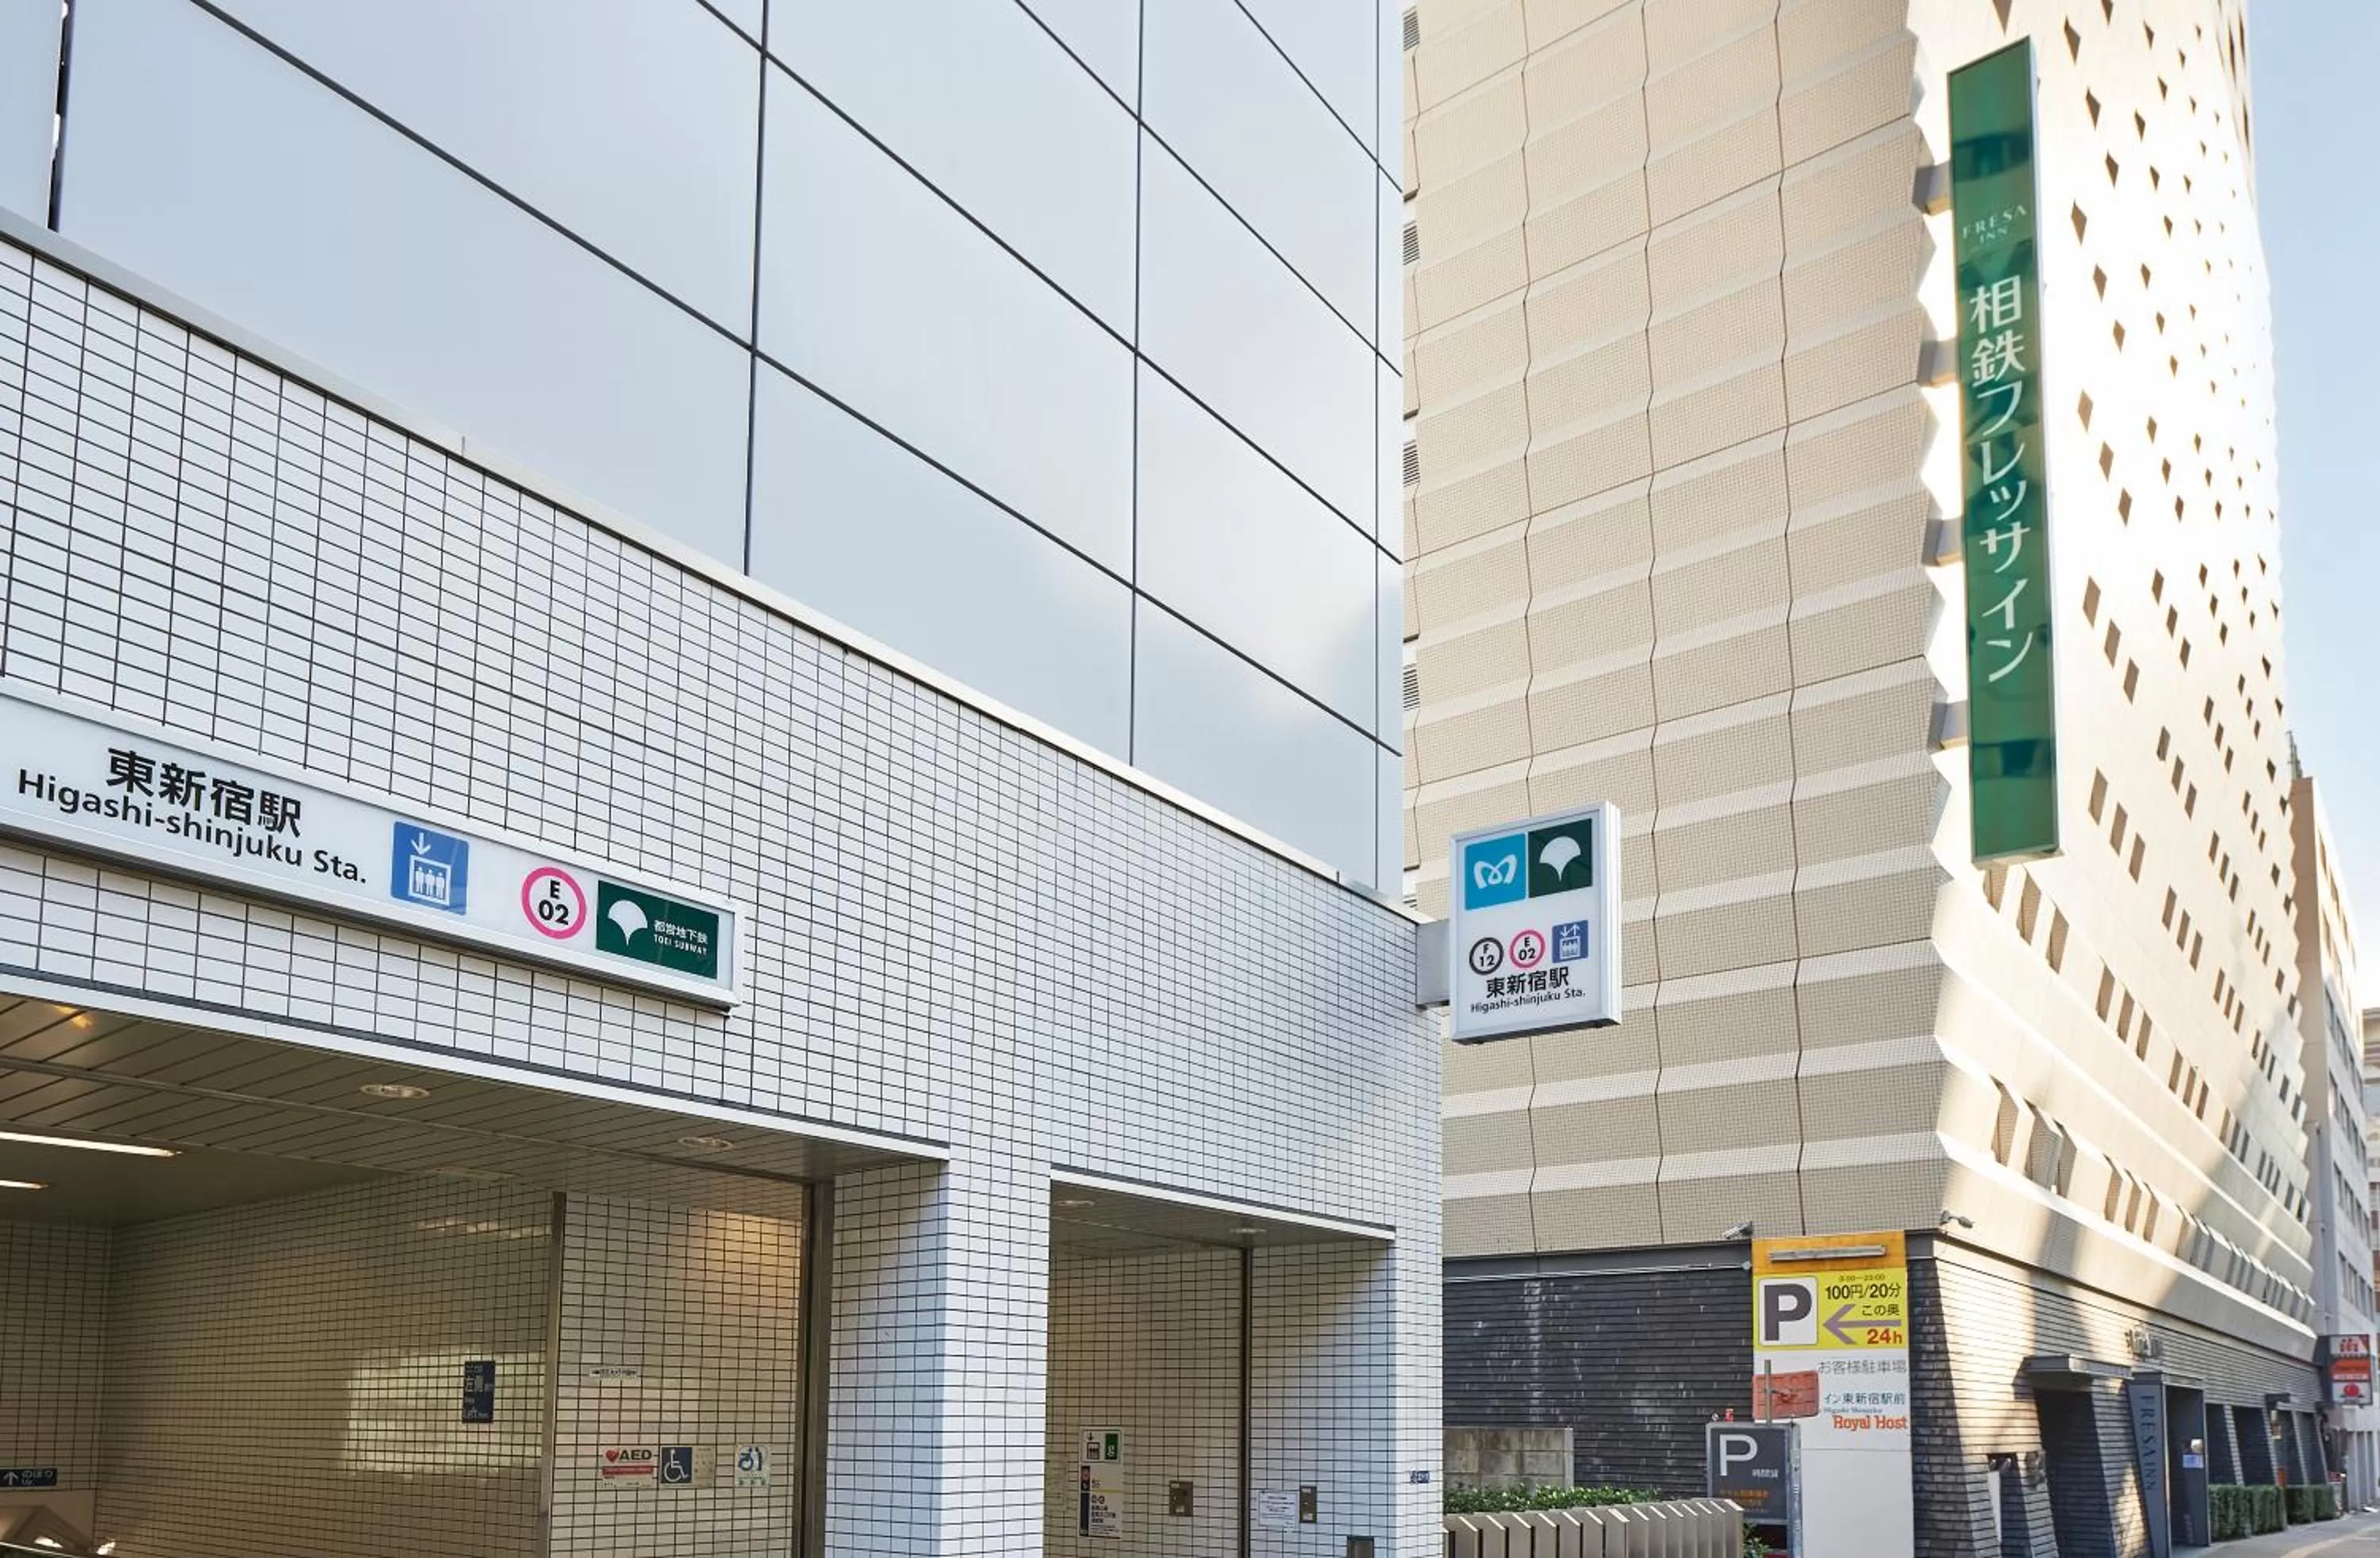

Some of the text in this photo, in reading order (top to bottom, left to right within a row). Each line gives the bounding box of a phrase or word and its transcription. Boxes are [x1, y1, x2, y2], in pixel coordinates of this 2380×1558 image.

[1968, 274, 2033, 685] 相鉄フレッサイン
[106, 746, 301, 838] 東新宿駅
[17, 767, 367, 884] Higashi-shinjuku Sta.
[549, 880, 561, 900] E
[538, 899, 570, 926] 02
[654, 919, 708, 944] 都営地下鉄
[654, 934, 673, 946] TOEI
[1483, 943, 1490, 954] F
[1523, 936, 1530, 948] E
[1479, 954, 1495, 967] 12
[1518, 948, 1537, 961] 02
[1485, 965, 1569, 999] 東新宿駅
[1470, 988, 1587, 1014] Higashi-shinjuku Sta.
[1825, 1283, 1902, 1300] 100円/20分
[1764, 1283, 1813, 1341] P
[1861, 1303, 1900, 1317] この奥
[1866, 1328, 1903, 1345] 24h
[1818, 1359, 1907, 1375] お客様駐車場
[1833, 1414, 1908, 1432] Royal Host
[619, 1449, 652, 1461] AED
[1718, 1433, 1759, 1476] P
